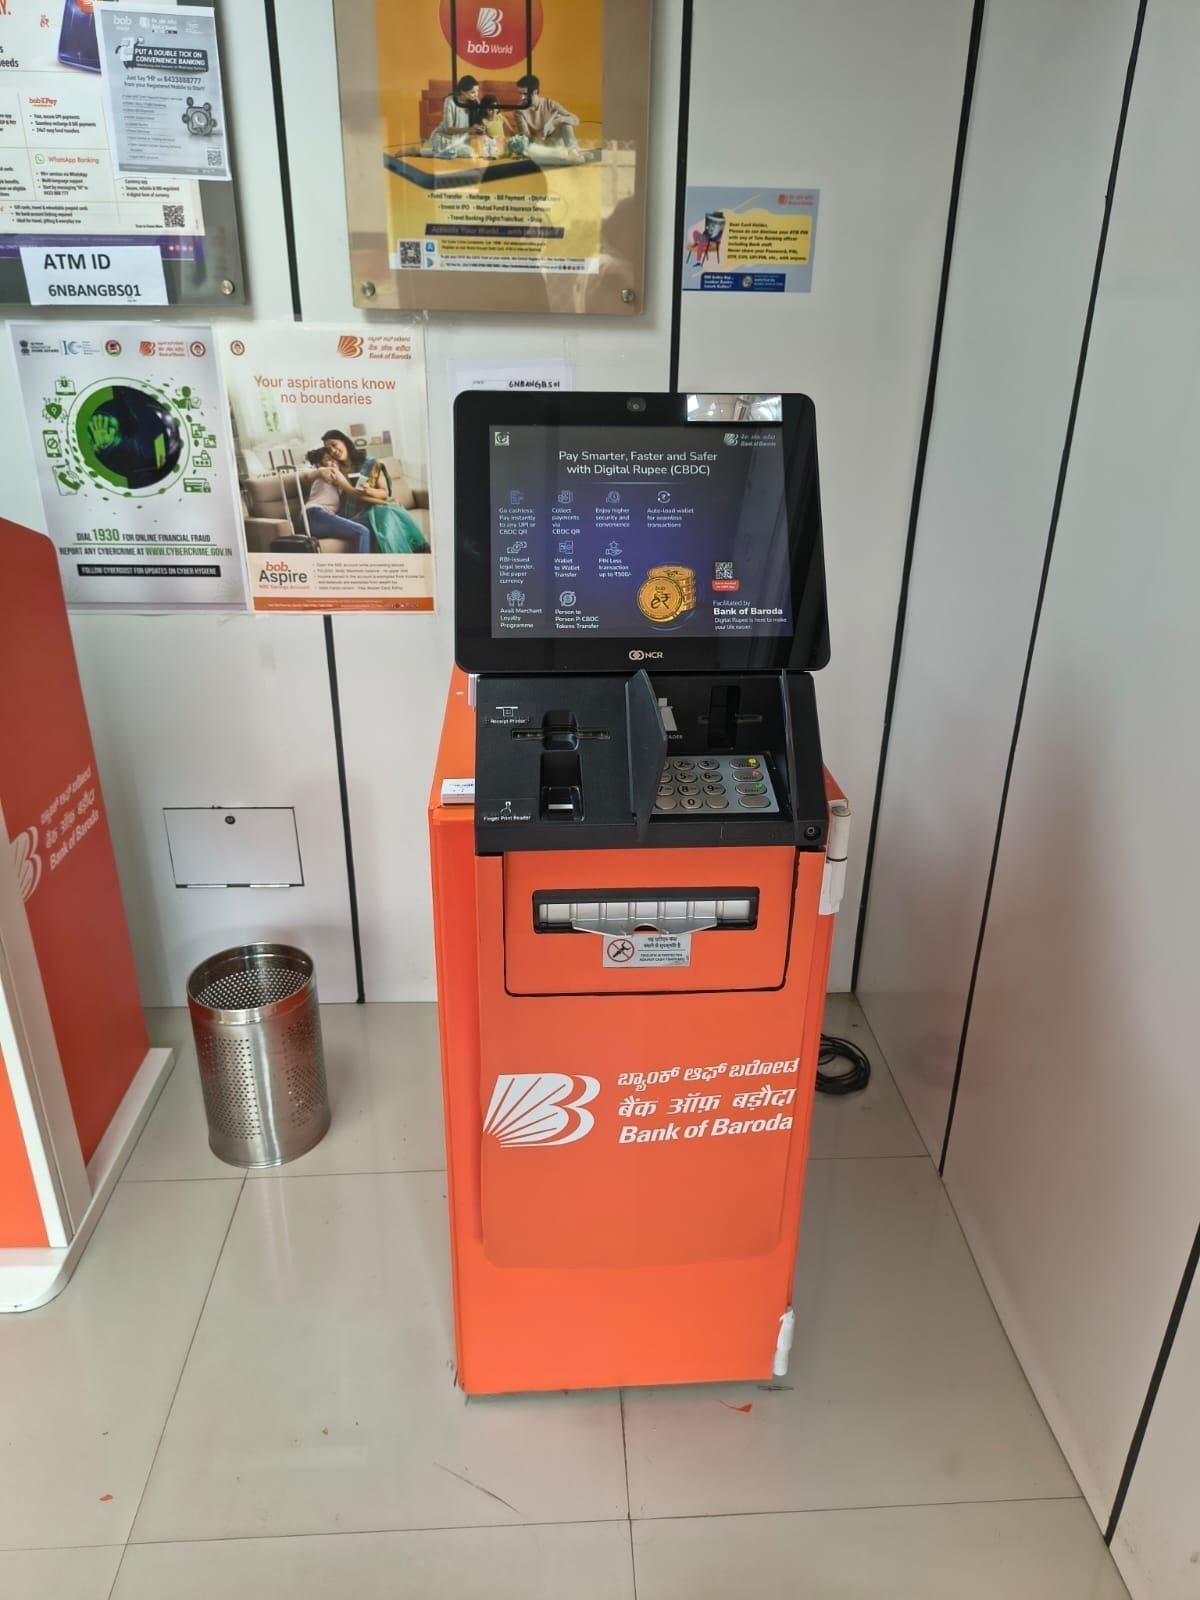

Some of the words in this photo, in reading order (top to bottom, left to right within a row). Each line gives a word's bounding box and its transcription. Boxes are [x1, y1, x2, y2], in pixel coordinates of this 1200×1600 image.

[467, 40, 490, 54] bob
[490, 45, 513, 54] World
[136, 56, 178, 64] CONVENIENCE
[44, 254, 86, 270] ATM
[92, 254, 110, 270] ID
[48, 284, 141, 297] 6NBANGBS01
[254, 376, 284, 388] Your
[287, 377, 358, 391] aspirations
[362, 378, 396, 390] know
[281, 394, 296, 403] no
[300, 392, 372, 405] boundaries
[559, 451, 578, 462] Pay
[581, 451, 628, 462] Smarter,
[630, 451, 664, 461] Faster
[667, 451, 686, 461] and
[690, 451, 718, 461] Safer
[567, 465, 591, 474] with
[594, 465, 629, 476] Digital
[633, 465, 668, 476] Rupee
[670, 465, 710, 476] (CBDC)
[76, 533, 92, 541] DIAL
[92, 528, 120, 541] 1930
[266, 561, 288, 572] bob
[259, 570, 308, 585] Aspire
[50, 841, 69, 871] Bank
[69, 830, 76, 849] of
[76, 809, 99, 841] Baroda
[618, 1066, 680, 1092] ಬ್ಯಾಂಕ್
[618, 1096, 659, 1117] बैंक
[666, 1092, 722, 1115] ऑफ़
[732, 1084, 797, 1110] बड़ौदा
[619, 1123, 681, 1144] Bank
[684, 1120, 710, 1138] of
[711, 1113, 793, 1136] Baroda
